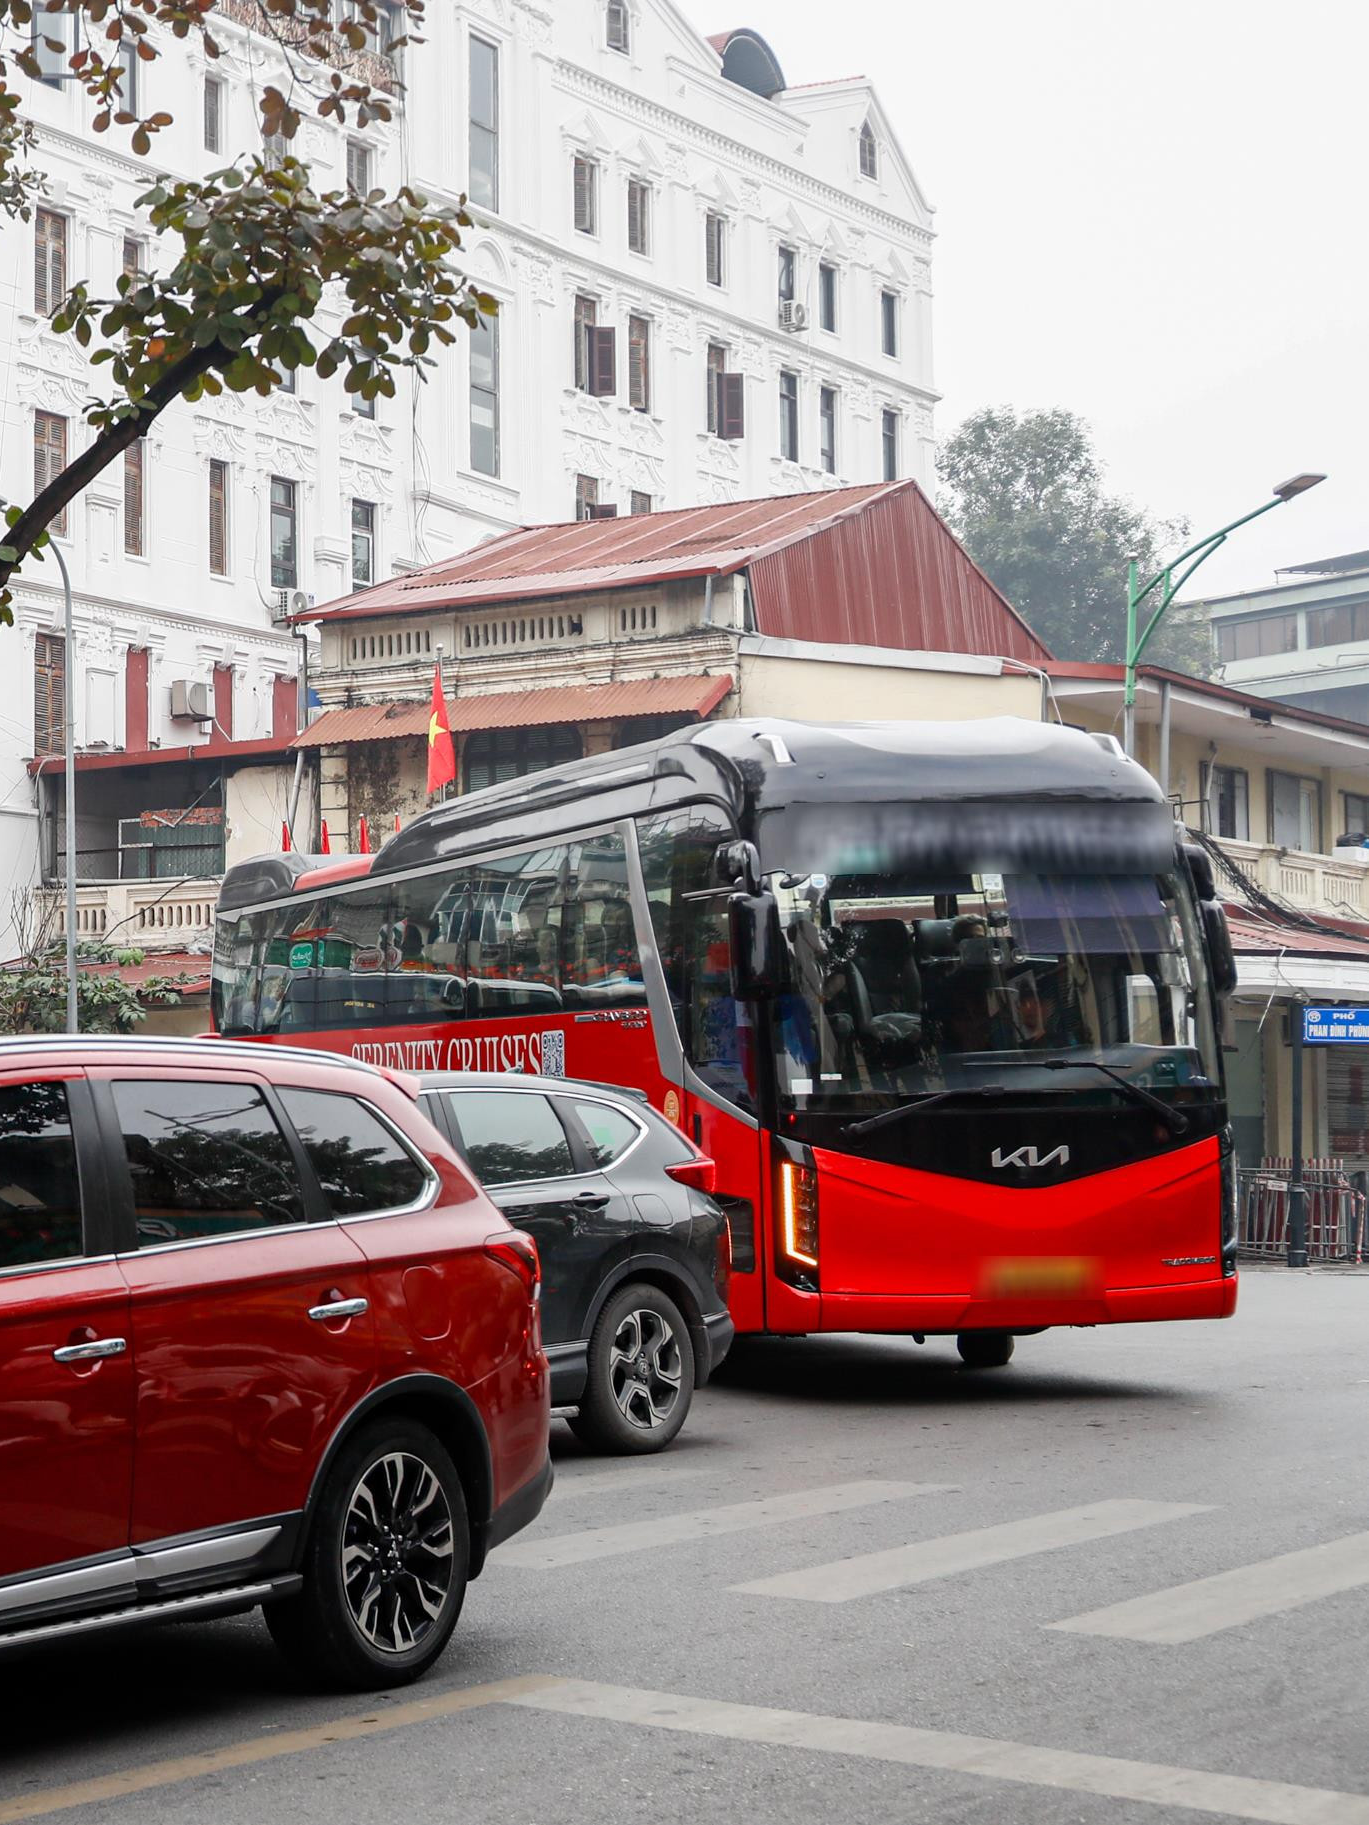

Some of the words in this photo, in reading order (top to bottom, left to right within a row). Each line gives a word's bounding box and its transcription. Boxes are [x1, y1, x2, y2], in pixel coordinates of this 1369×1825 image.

[1333, 1010, 1355, 1020] PHỐ
[1308, 1025, 1328, 1037] PHAN
[1348, 1022, 1369, 1038] PHÙN
